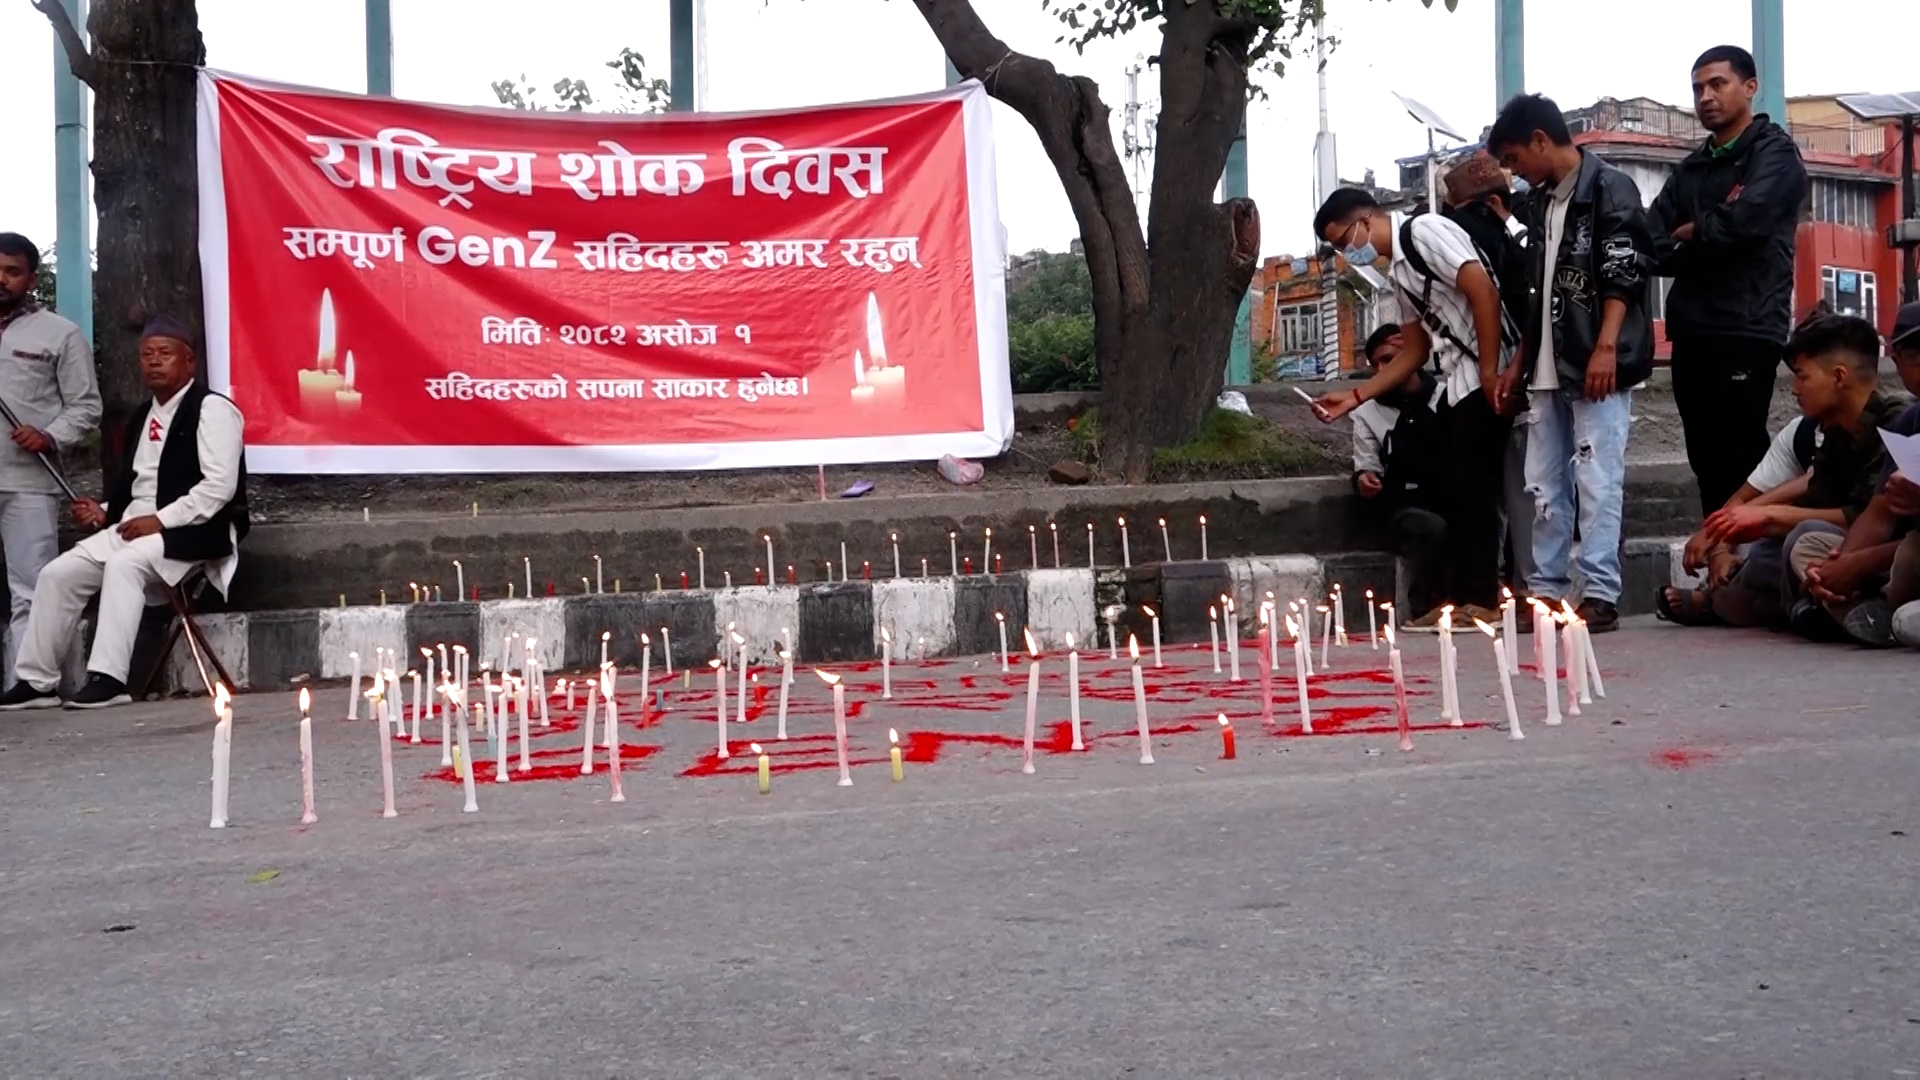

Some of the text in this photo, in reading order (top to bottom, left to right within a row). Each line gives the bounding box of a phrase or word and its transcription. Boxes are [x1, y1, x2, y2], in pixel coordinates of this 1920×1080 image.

[306, 127, 889, 210] राष्ट्रिय शोक दिवस
[283, 226, 406, 270] सम्पूर्ण
[418, 226, 558, 270] GenZ
[741, 238, 830, 269] अमर
[840, 236, 923, 273] रहुन्
[560, 325, 627, 346] २०८२
[637, 319, 719, 347] असोज
[734, 324, 752, 345] १
[576, 379, 646, 401] सपना
[652, 378, 731, 401] साकार
[737, 372, 810, 403] हुनेछ।
